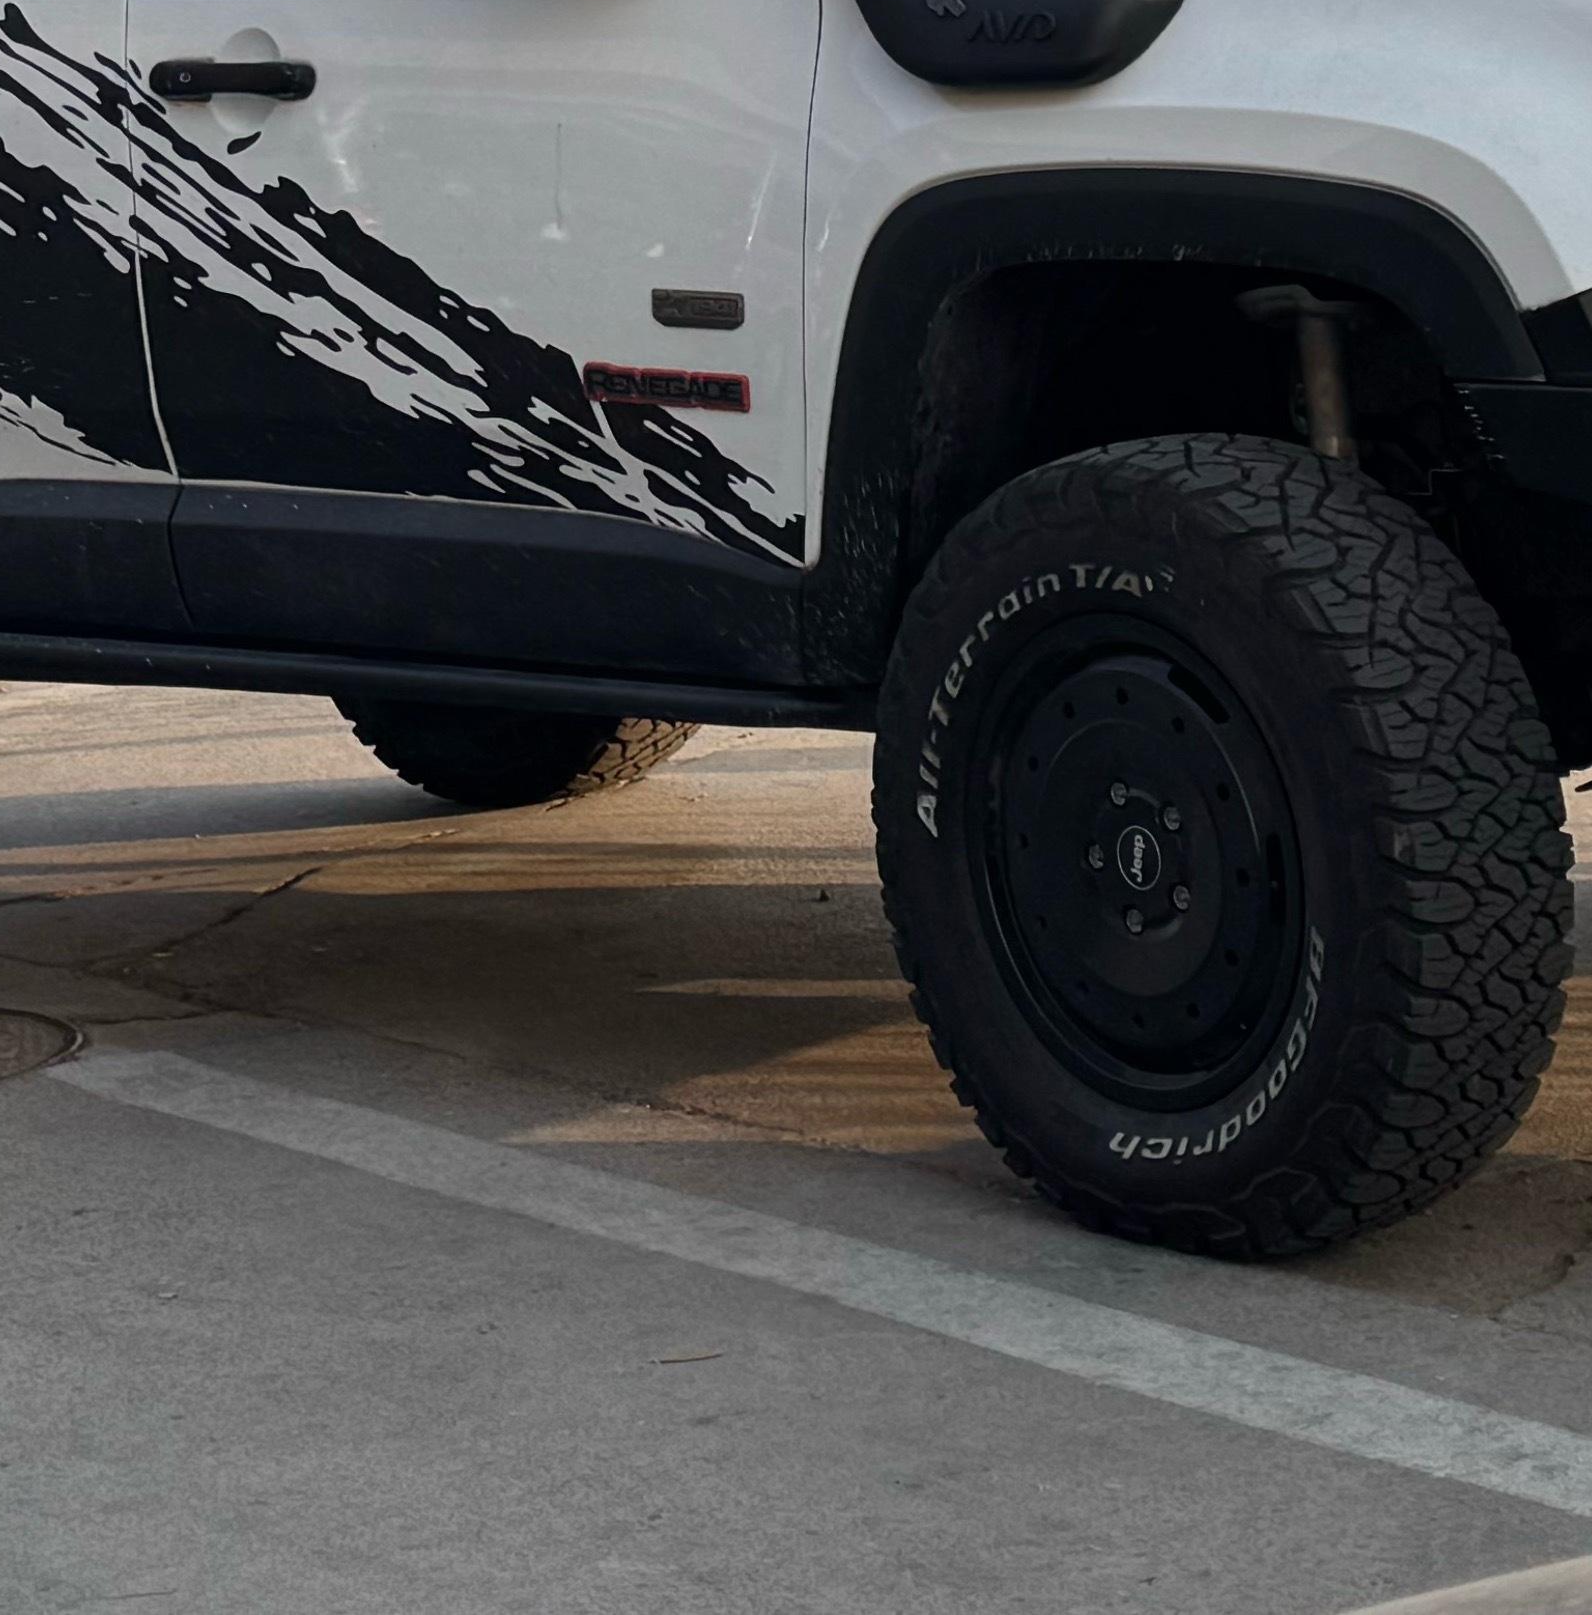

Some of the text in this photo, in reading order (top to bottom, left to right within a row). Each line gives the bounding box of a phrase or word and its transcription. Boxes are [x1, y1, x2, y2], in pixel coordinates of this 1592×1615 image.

[585, 366, 746, 408] RENEGADE
[916, 571, 1061, 839] All-Terrain
[1130, 834, 1147, 883] Jeep
[1109, 925, 1325, 1166] BFGoodrich
